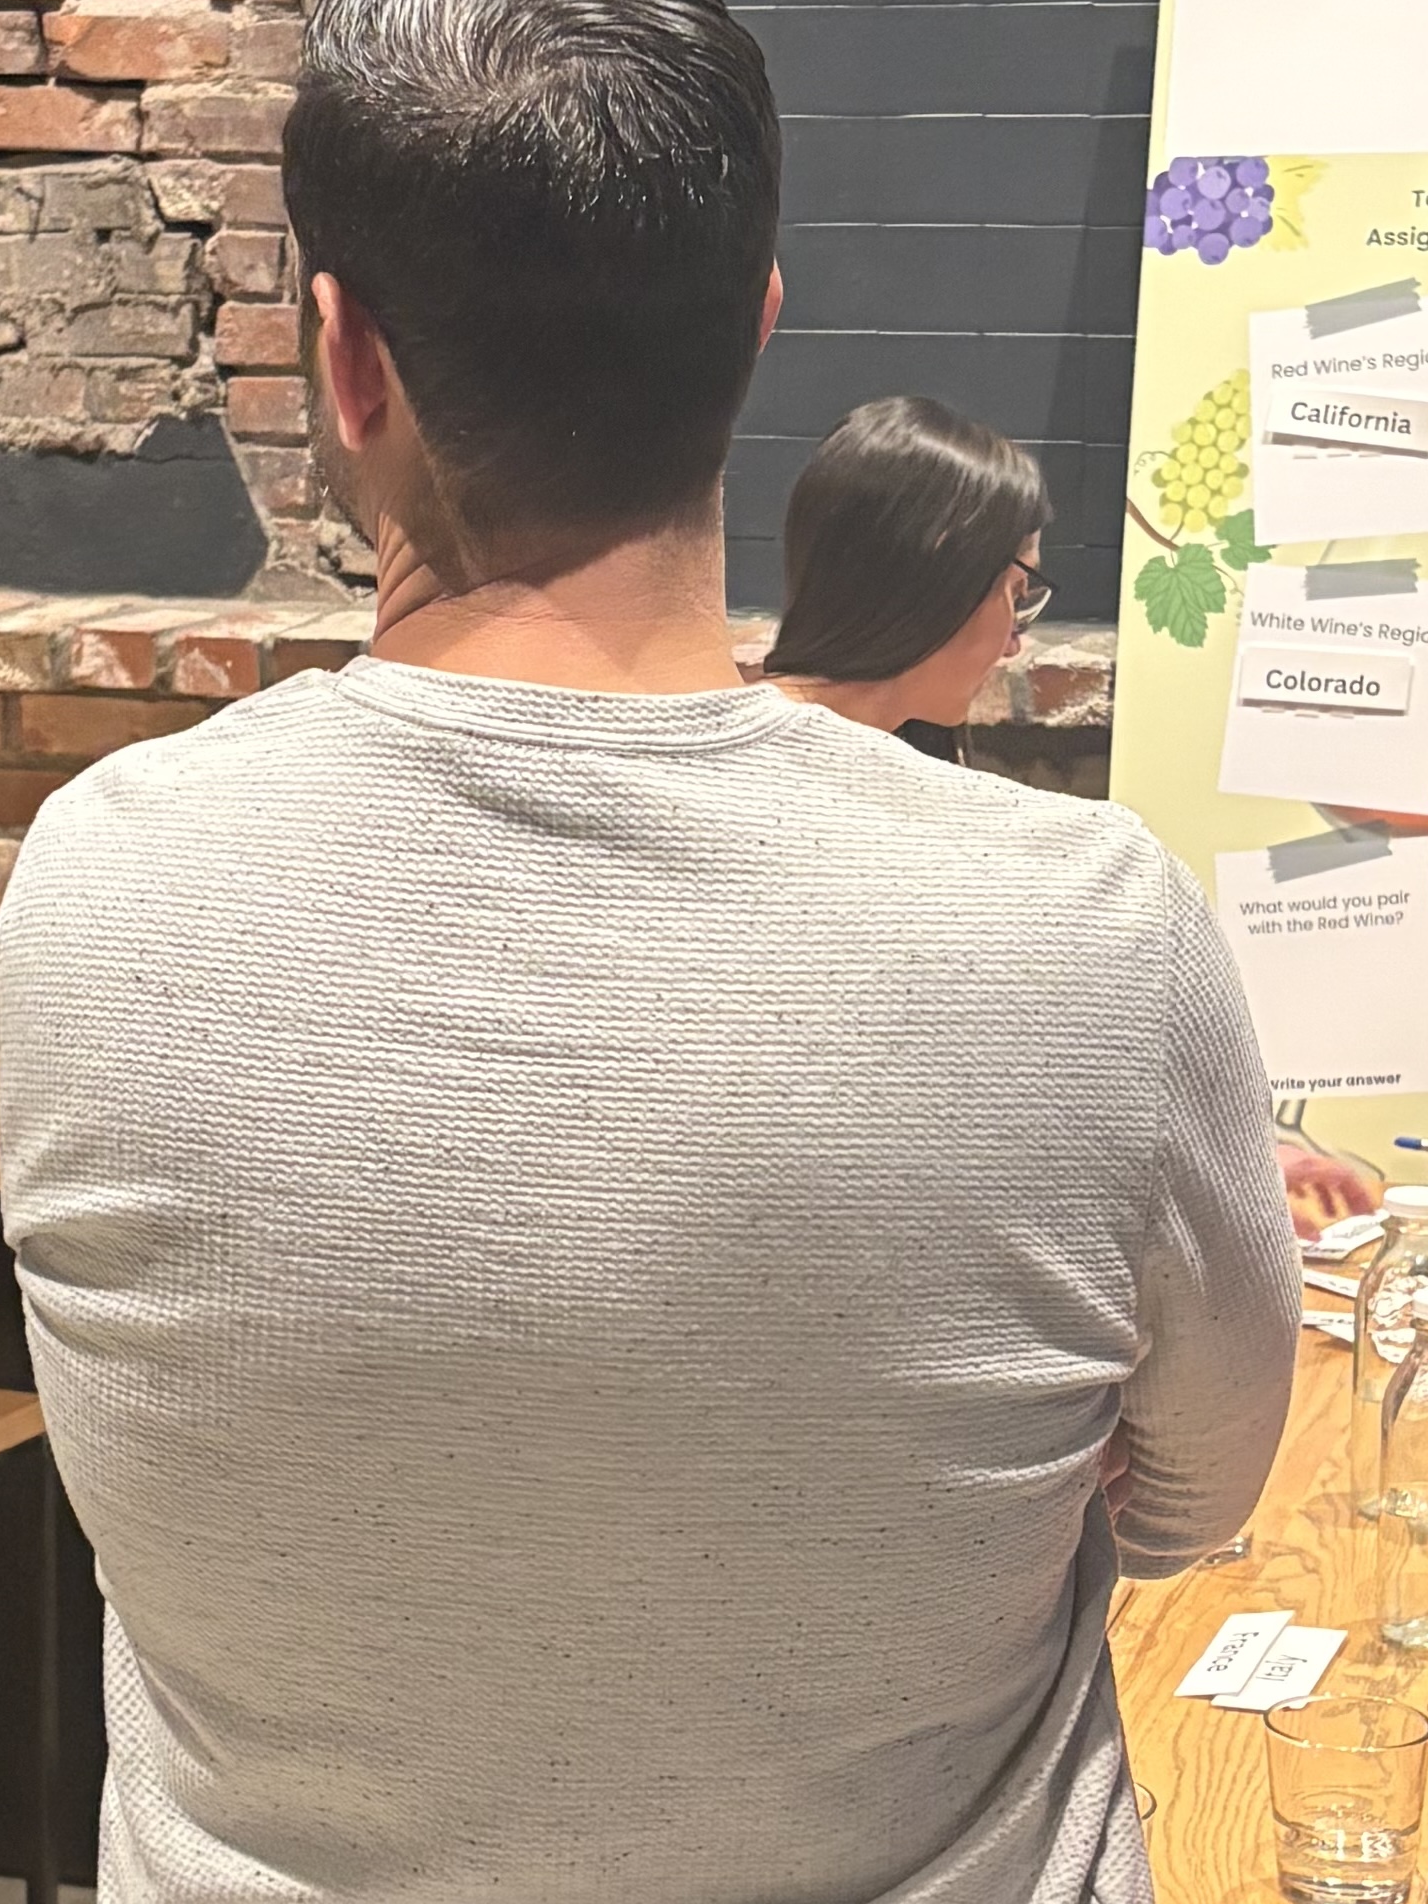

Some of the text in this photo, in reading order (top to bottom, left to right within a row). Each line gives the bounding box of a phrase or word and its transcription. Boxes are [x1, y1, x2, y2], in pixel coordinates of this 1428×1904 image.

[1272, 361, 1308, 378] Red
[1313, 356, 1377, 375] Wine's
[1291, 402, 1411, 434] California
[1251, 611, 1305, 631] White
[1311, 617, 1373, 637] Wine's
[1266, 670, 1380, 696] Colorado
[1240, 890, 1410, 915] What would you pair
[1248, 911, 1404, 935] with the Red Wine?
[1309, 1078, 1342, 1092] your
[1346, 1074, 1401, 1086] answer
[1207, 1632, 1259, 1672] France
[1255, 1655, 1307, 1681] Italy
